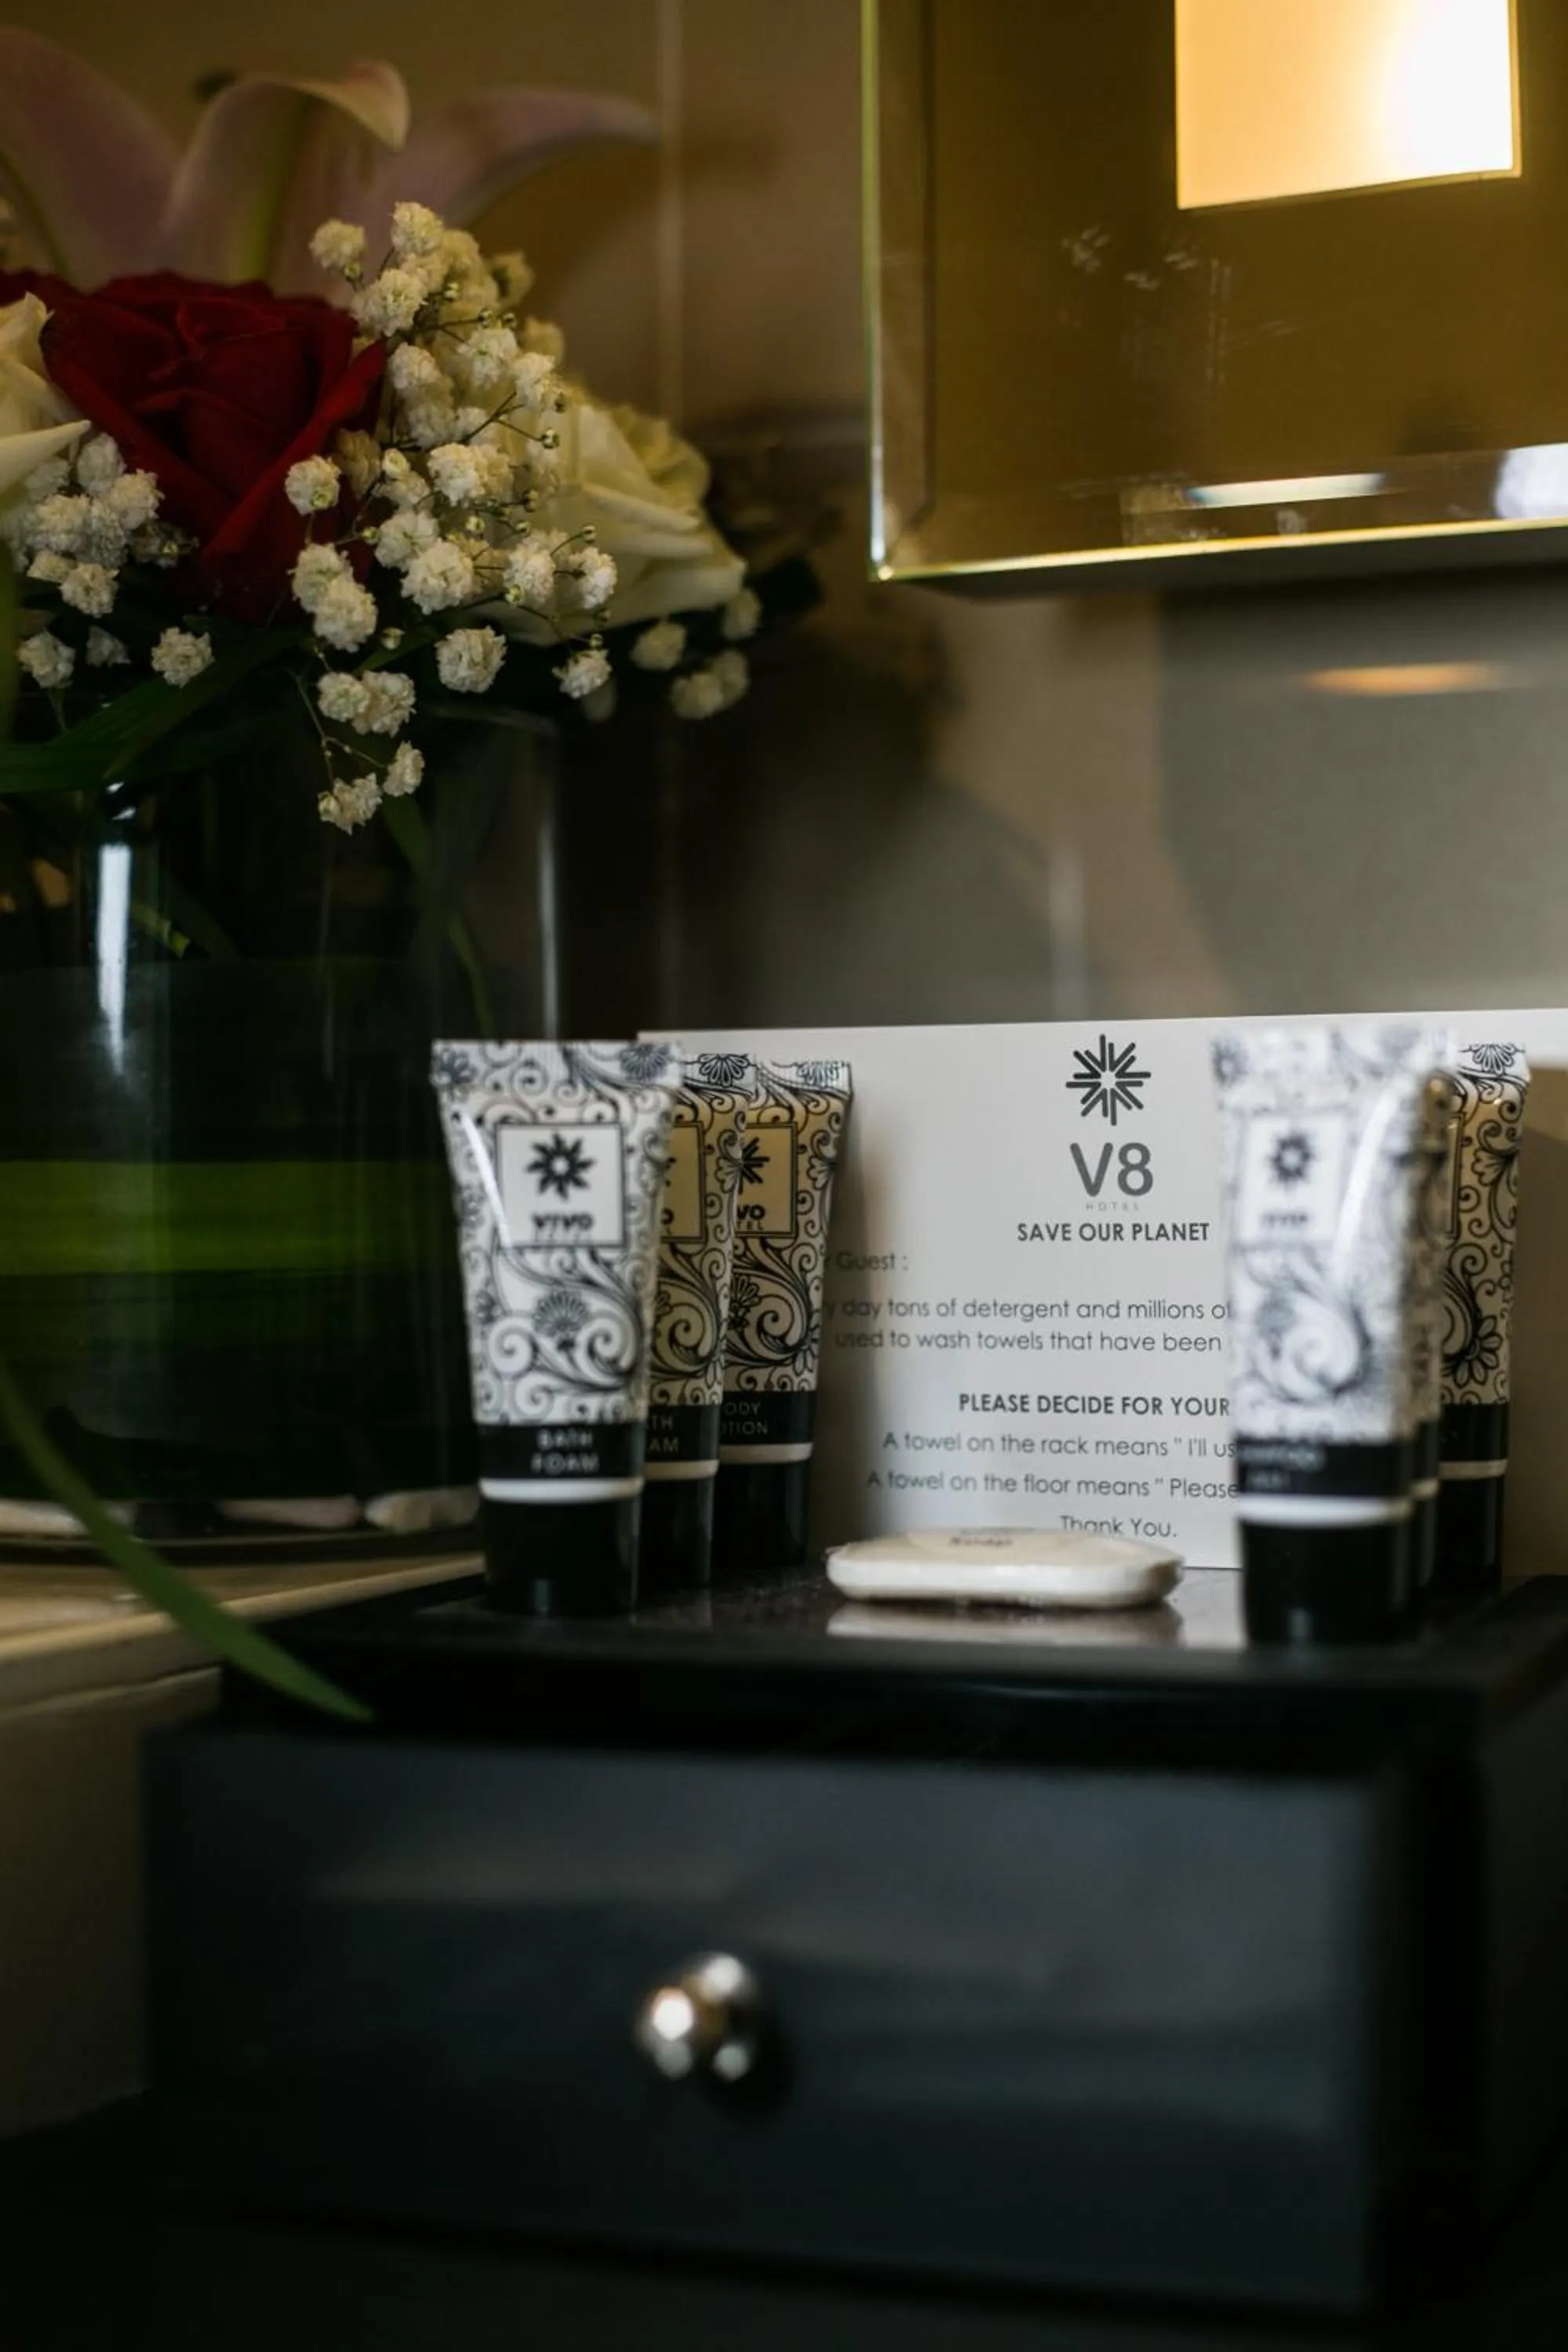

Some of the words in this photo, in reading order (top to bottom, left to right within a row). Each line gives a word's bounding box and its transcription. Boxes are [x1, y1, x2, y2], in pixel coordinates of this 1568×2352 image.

[1070, 1142, 1153, 1197] V8
[738, 1204, 765, 1220] VO
[1086, 1202, 1140, 1211] HOTEL
[1017, 1223, 1072, 1242] SAVE
[1079, 1223, 1123, 1242] OUR
[1132, 1222, 1210, 1242] PLANET
[836, 1250, 895, 1271] Guest
[842, 1298, 884, 1320] day
[888, 1298, 931, 1317] tons
[936, 1298, 956, 1317] of
[963, 1298, 1070, 1323] detergent
[1076, 1300, 1120, 1319] and
[1128, 1300, 1205, 1319] millions
[890, 1330, 911, 1348] to
[916, 1330, 971, 1348] wash
[978, 1331, 1044, 1349] towels
[1051, 1332, 1093, 1350] that
[1100, 1333, 1156, 1351] have
[1163, 1333, 1221, 1352] been
[724, 1402, 760, 1415] ODY
[959, 1393, 1029, 1412] PLEASE
[1037, 1395, 1114, 1414] DECIDE
[1121, 1396, 1163, 1414] FOR
[882, 1432, 898, 1449] A
[904, 1432, 961, 1450] towel
[967, 1436, 994, 1451] on
[1001, 1434, 1035, 1453] the
[1041, 1436, 1088, 1454] rack
[1095, 1439, 1168, 1456] means
[1214, 1442, 1236, 1457] us
[866, 1469, 882, 1487] A
[887, 1470, 944, 1490] towel
[949, 1475, 978, 1490] on
[984, 1473, 1017, 1492] the
[1023, 1473, 1072, 1494] floor
[1077, 1479, 1150, 1496] means
[1170, 1479, 1240, 1498] Please
[1060, 1515, 1123, 1534] Thank
[1131, 1518, 1178, 1537] You.
